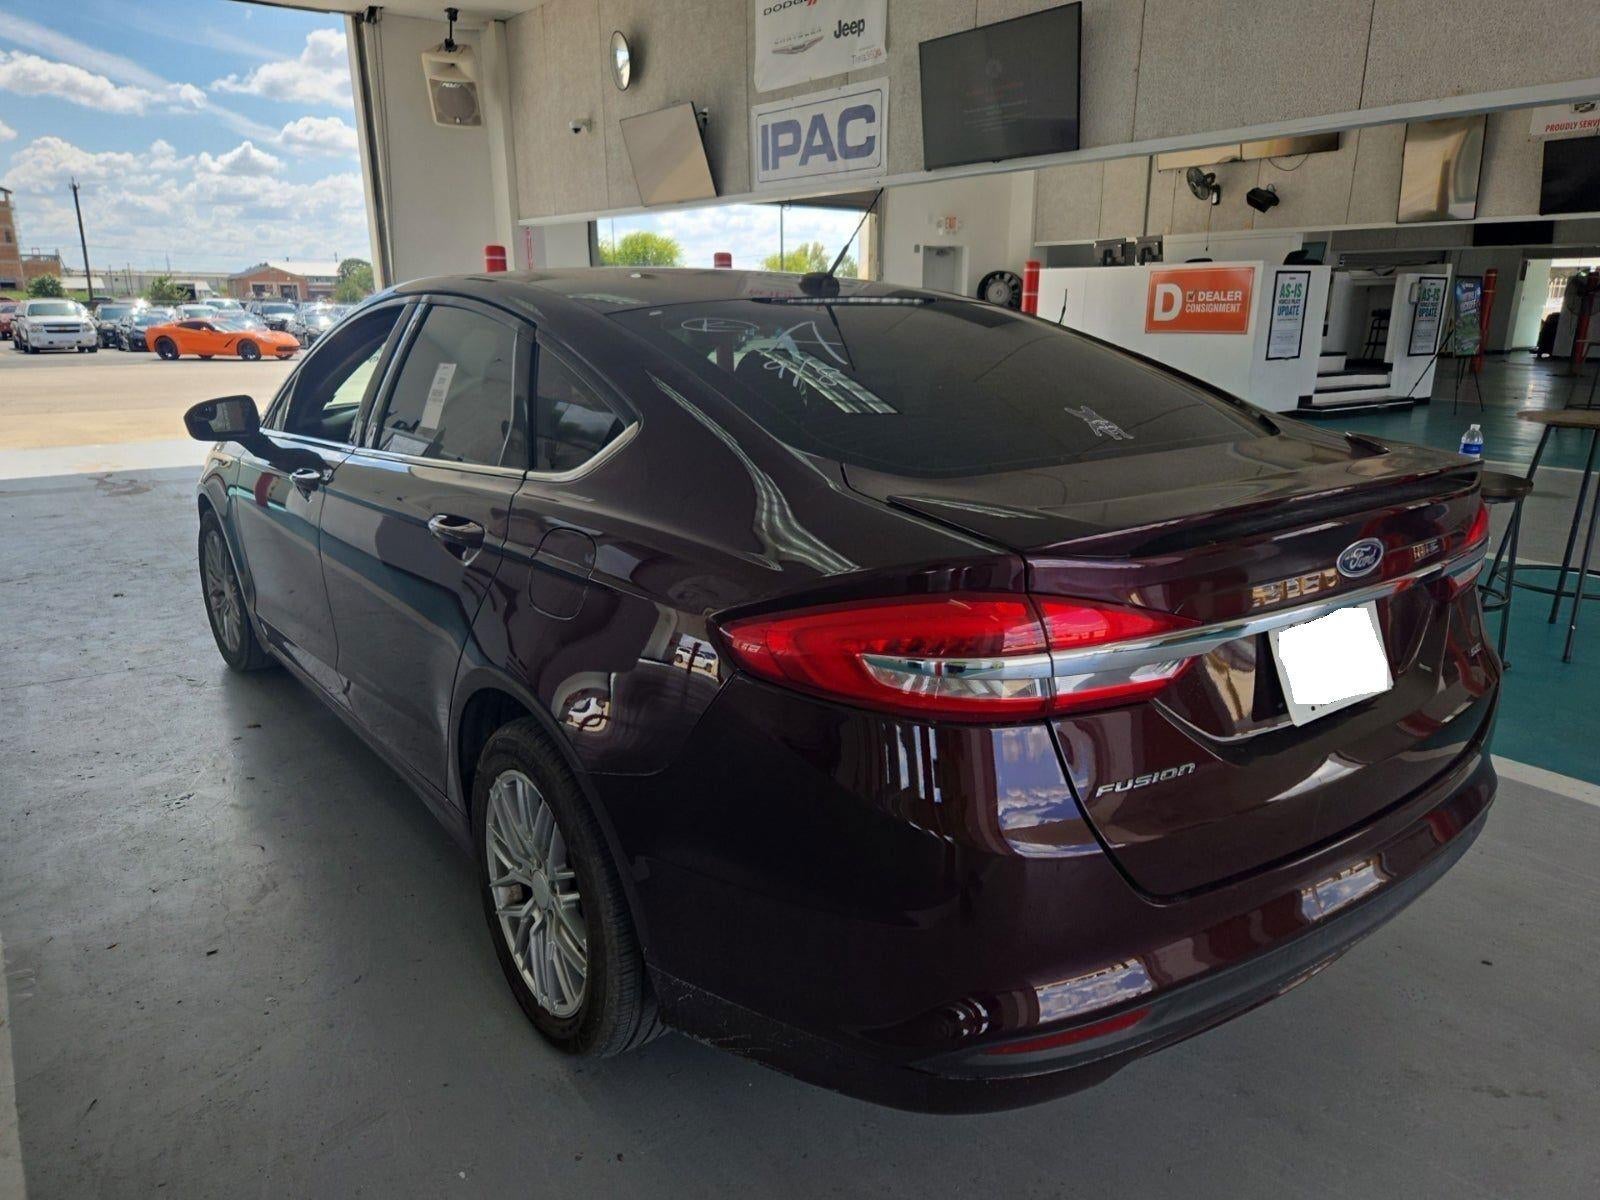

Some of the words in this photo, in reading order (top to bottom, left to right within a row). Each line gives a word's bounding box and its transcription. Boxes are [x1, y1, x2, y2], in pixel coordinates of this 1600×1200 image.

[834, 18, 865, 38] Jeep
[1545, 121, 1578, 132] PROUDLY
[761, 104, 875, 171] IPAC
[1280, 283, 1302, 298] AS-IS
[1153, 283, 1182, 321] D
[1197, 291, 1242, 301] DEALER
[1185, 303, 1240, 313] CONSIGNMENT
[1277, 305, 1300, 316] UPDATE
[1096, 762, 1195, 797] FUSION
